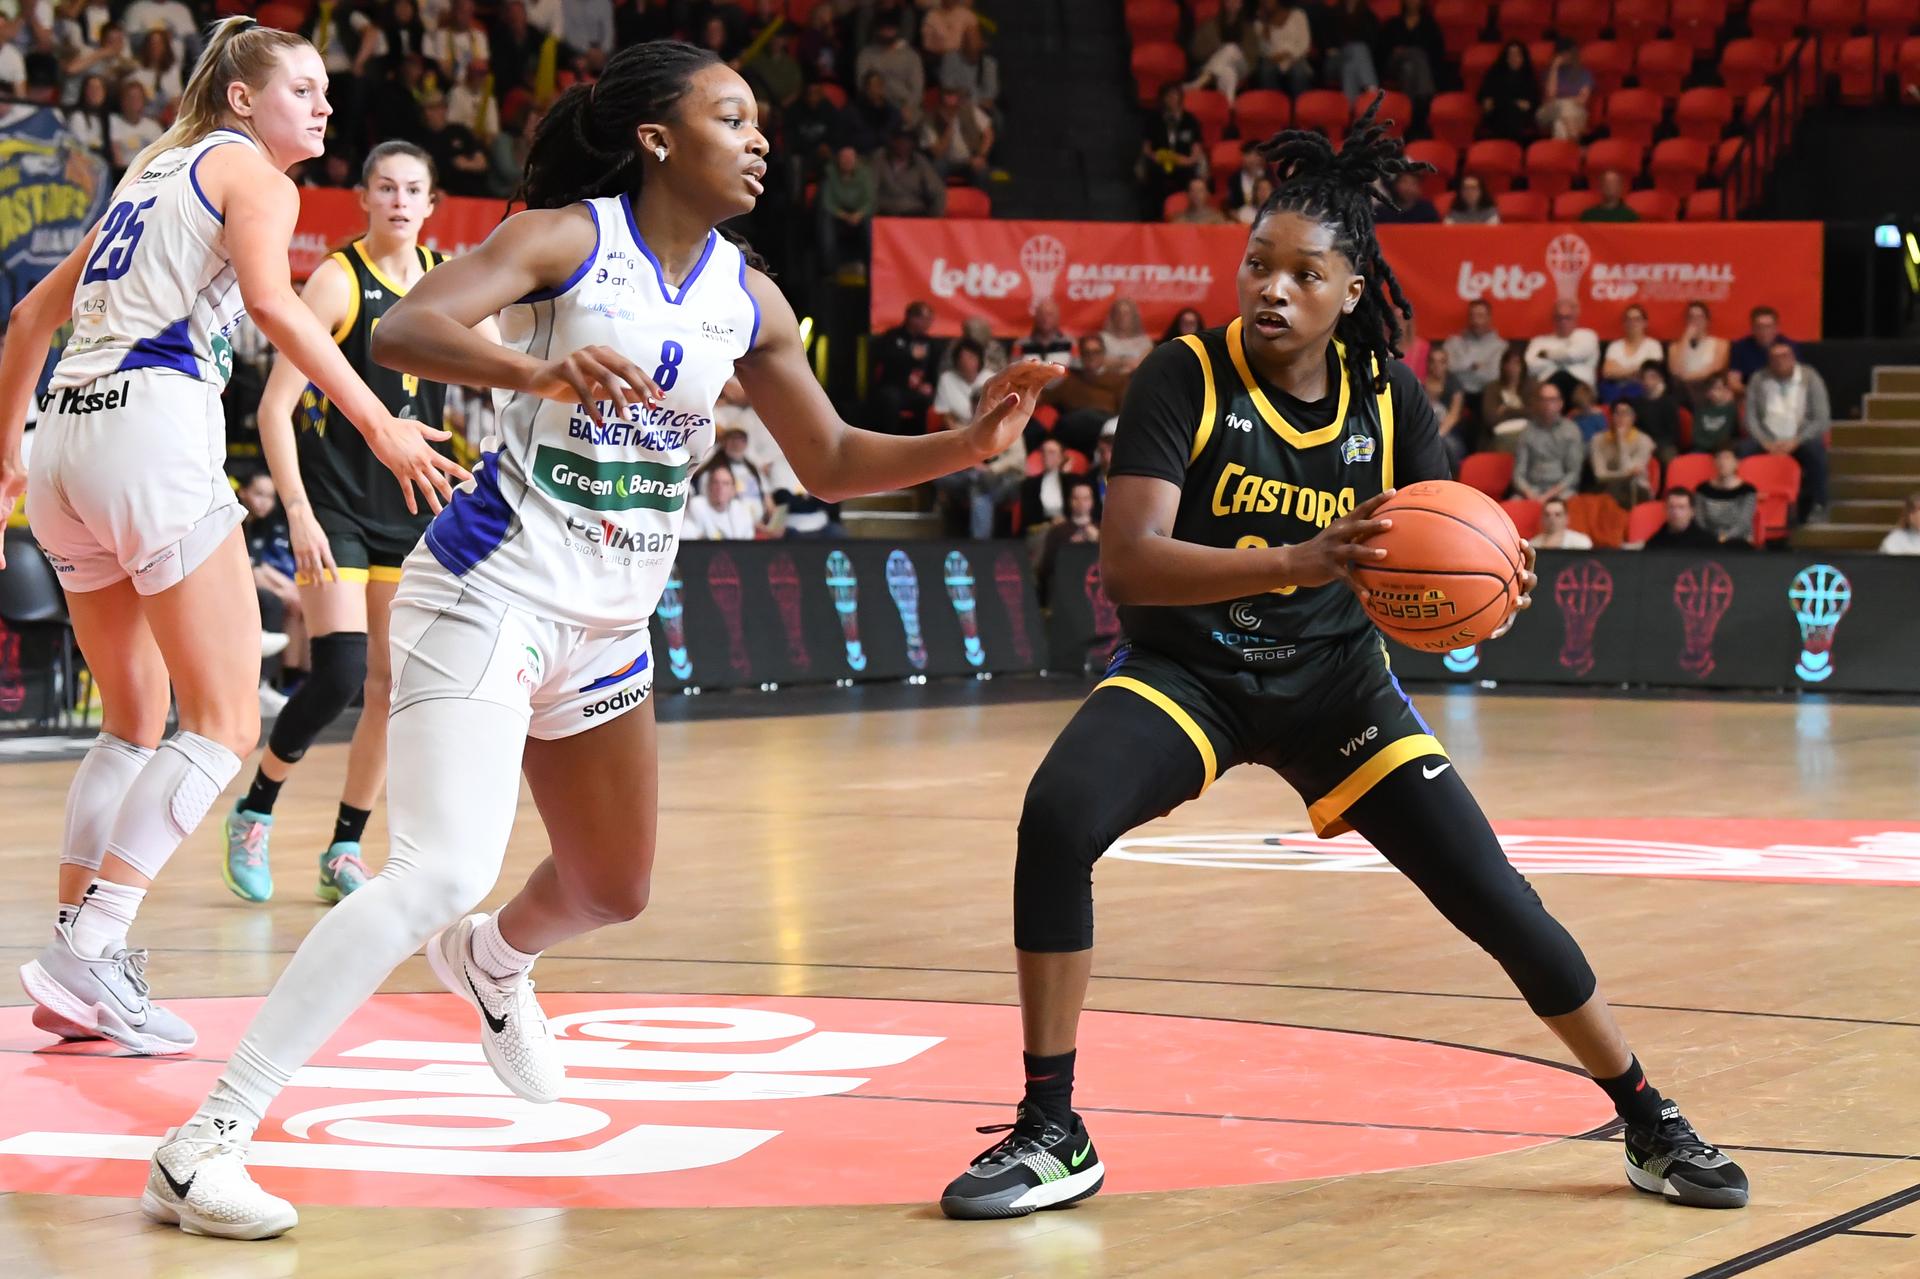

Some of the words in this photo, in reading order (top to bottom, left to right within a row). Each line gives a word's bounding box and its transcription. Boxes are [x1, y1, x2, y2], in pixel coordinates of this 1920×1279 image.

[82, 195, 158, 285] 25
[1067, 264, 1213, 282] BASKETBALL
[1592, 263, 1735, 282] BASKETBALL
[1067, 283, 1115, 301] CUP
[1591, 282, 1639, 301] CUP
[651, 340, 683, 392] 8
[568, 417, 634, 447] BASKET
[551, 463, 612, 496] Green
[1367, 598, 1457, 619] LEGACY
[1244, 648, 1297, 662] GROEP
[1339, 724, 1379, 758] vive
